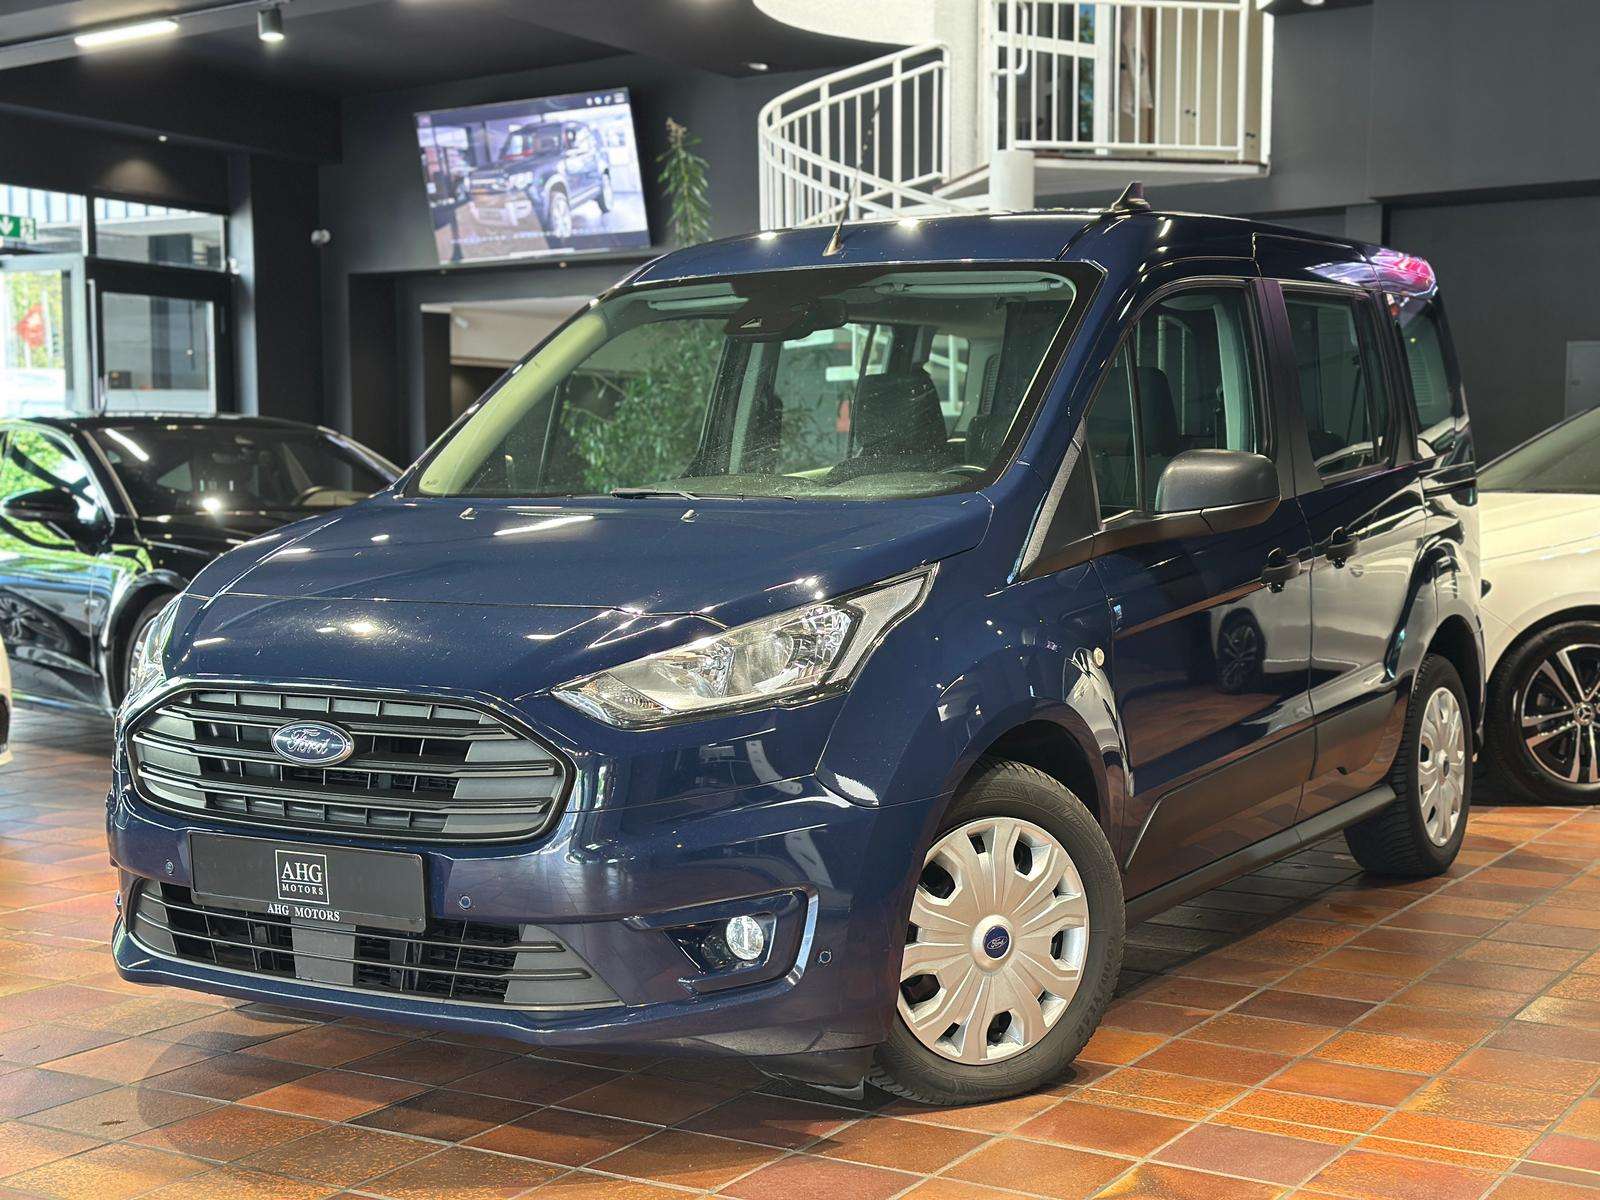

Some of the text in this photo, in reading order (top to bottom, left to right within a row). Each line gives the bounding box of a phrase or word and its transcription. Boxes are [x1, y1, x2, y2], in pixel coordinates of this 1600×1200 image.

[286, 728, 331, 755] Ford
[281, 861, 322, 883] AHG
[282, 883, 324, 896] MOTORS
[267, 903, 341, 922] AHG MOTORS
